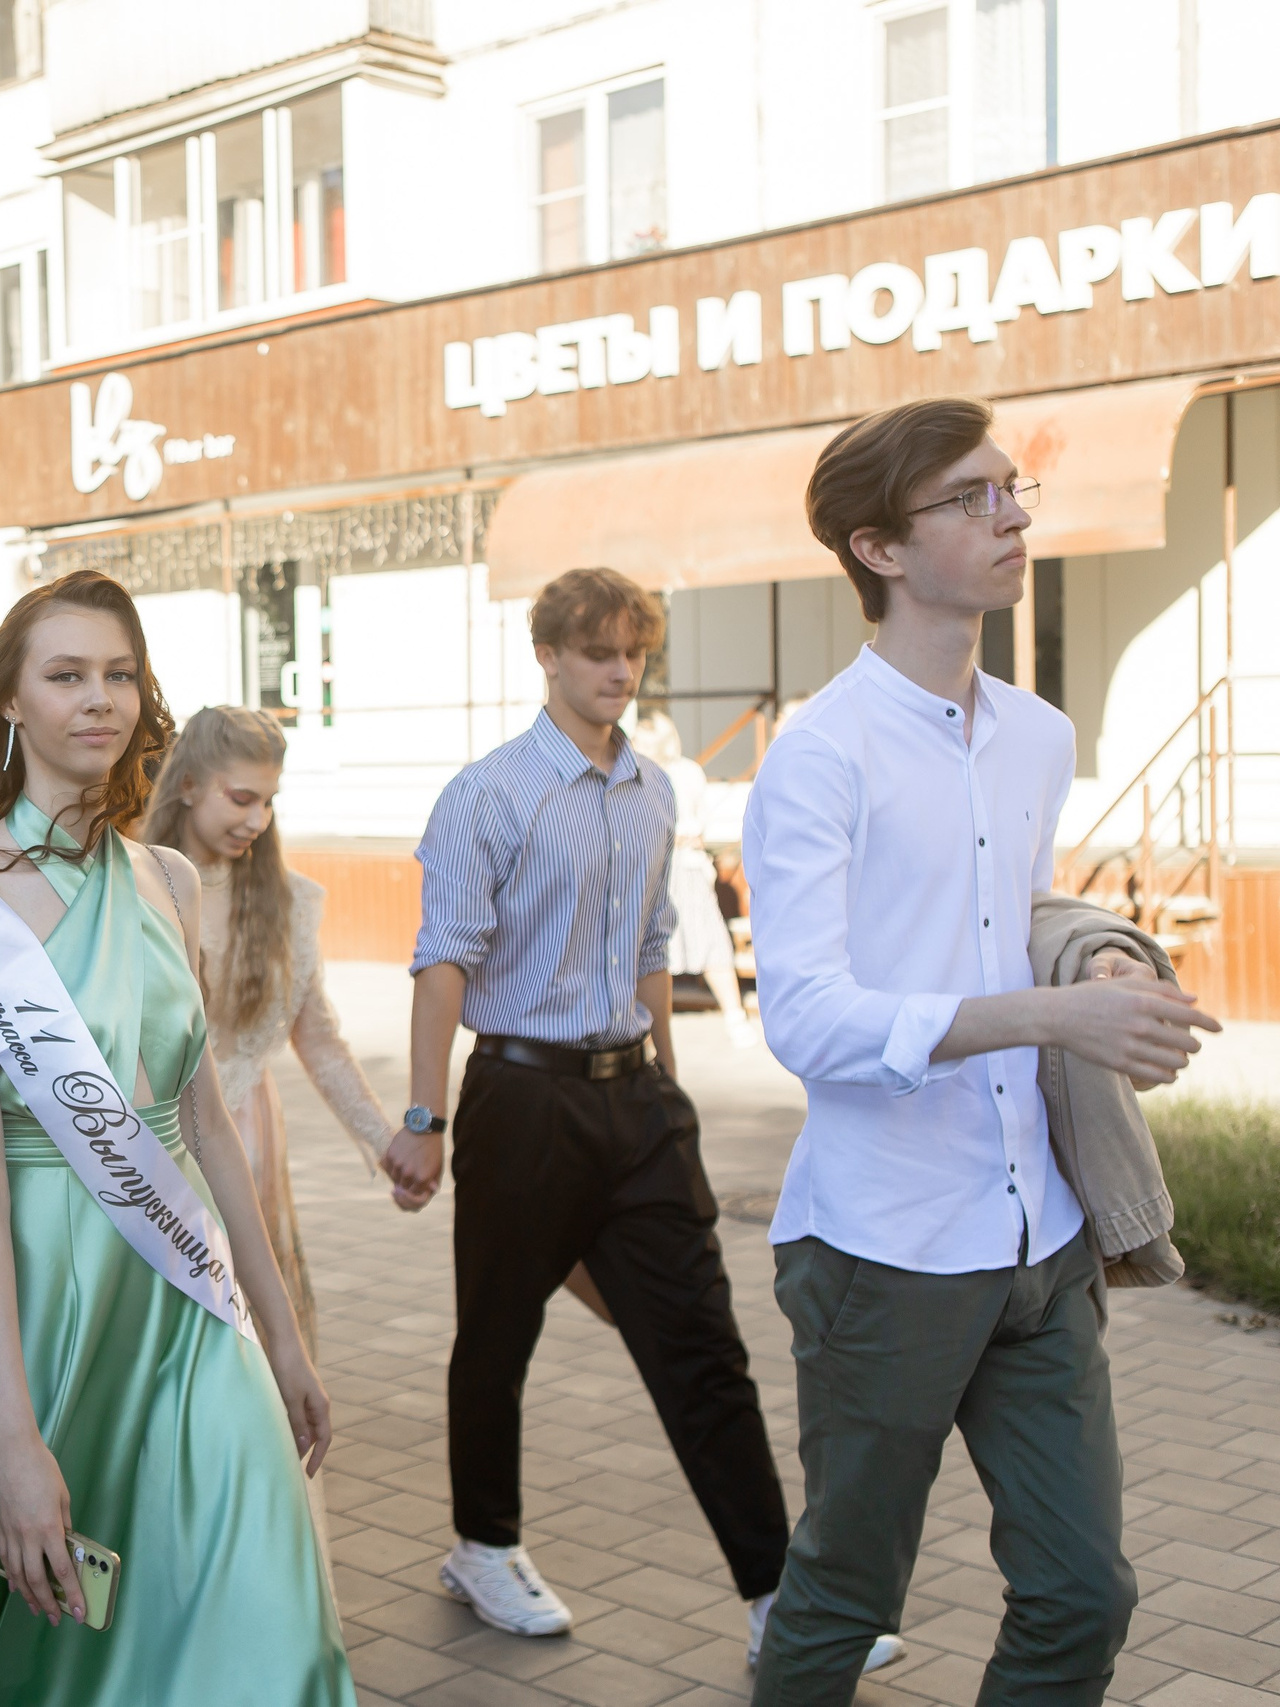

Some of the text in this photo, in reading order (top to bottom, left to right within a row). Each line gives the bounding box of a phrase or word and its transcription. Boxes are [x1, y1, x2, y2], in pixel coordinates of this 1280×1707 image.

[444, 192, 1280, 417] ЦВЕТЫ И ПОДАРКИ
[51, 1070, 226, 1284] Выпускница
